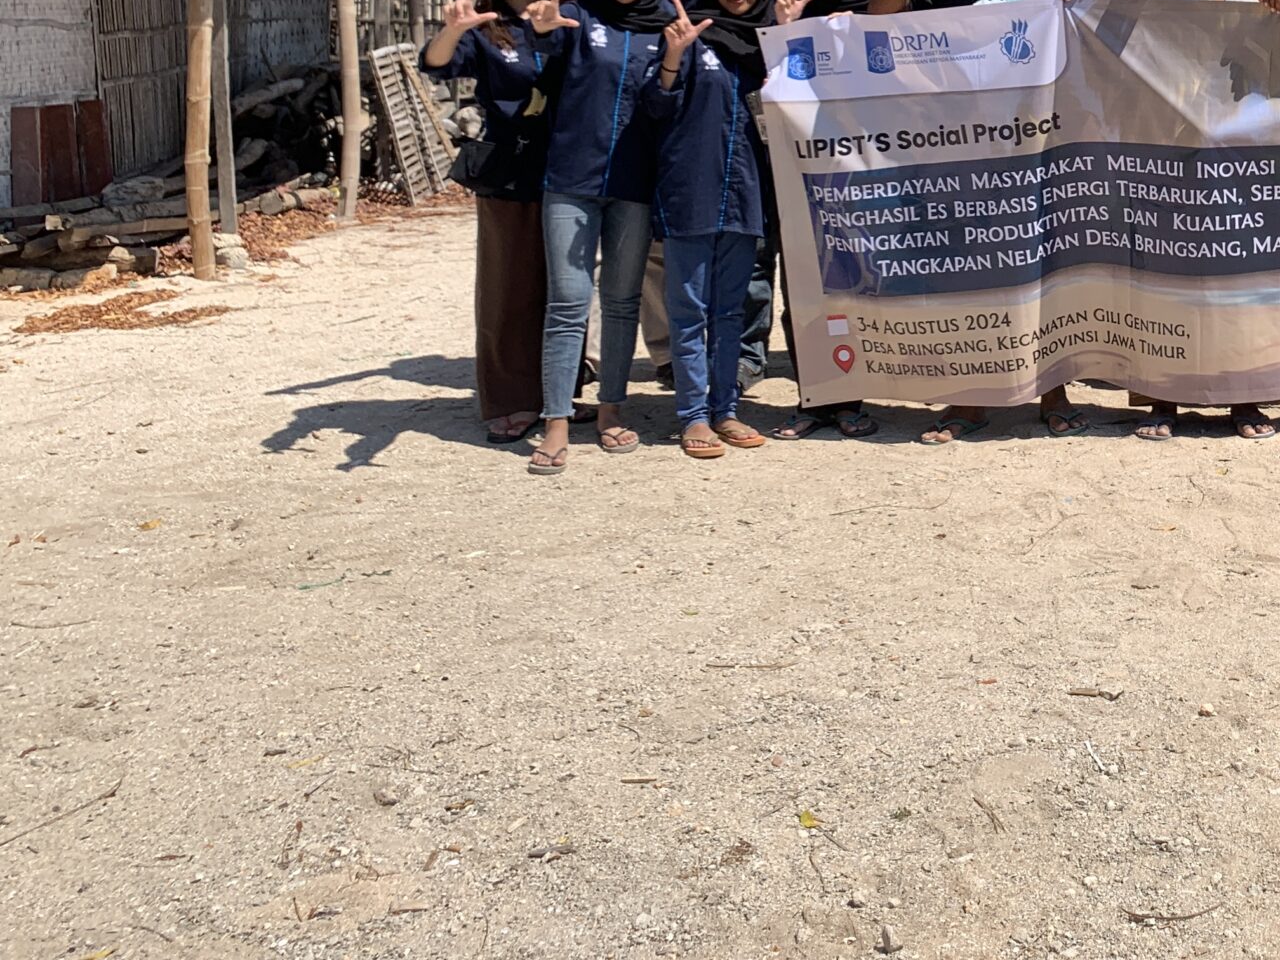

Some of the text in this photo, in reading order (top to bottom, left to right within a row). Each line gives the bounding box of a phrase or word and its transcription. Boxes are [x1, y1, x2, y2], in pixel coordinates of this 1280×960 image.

[890, 31, 949, 52] DRPM
[897, 124, 969, 150] Social
[973, 112, 1062, 147] Project
[812, 176, 961, 203] PEMBERDAYAAN
[971, 156, 1095, 190] MASYARAKAT
[1107, 154, 1184, 177] MELALUI
[1196, 159, 1275, 179] INOVASI
[819, 206, 920, 228] PENGHASIL
[954, 196, 1038, 219] BERBASIS
[1042, 181, 1110, 206] ENERGI
[1116, 179, 1244, 206] TERBARUKAN,
[823, 230, 950, 254] PENINGKATAN
[964, 206, 1110, 245] PRODUKTIVITAS
[1123, 207, 1158, 228] DAN
[1172, 212, 1265, 232] KUALITAS
[876, 253, 993, 278] TANGKAPAN
[997, 232, 1080, 269] NELAYAN
[1085, 229, 1131, 248] DESA
[1134, 235, 1248, 259] BRINGSANG,
[857, 312, 1012, 336] 3-4 AGUSTUS 2024
[861, 307, 1191, 357] DESA BRINGSANG, KECAMATAN GILI GENTING,
[865, 330, 1187, 378] KABUPATEN SUMENEP, PROVINSI JAWA TIMUR
